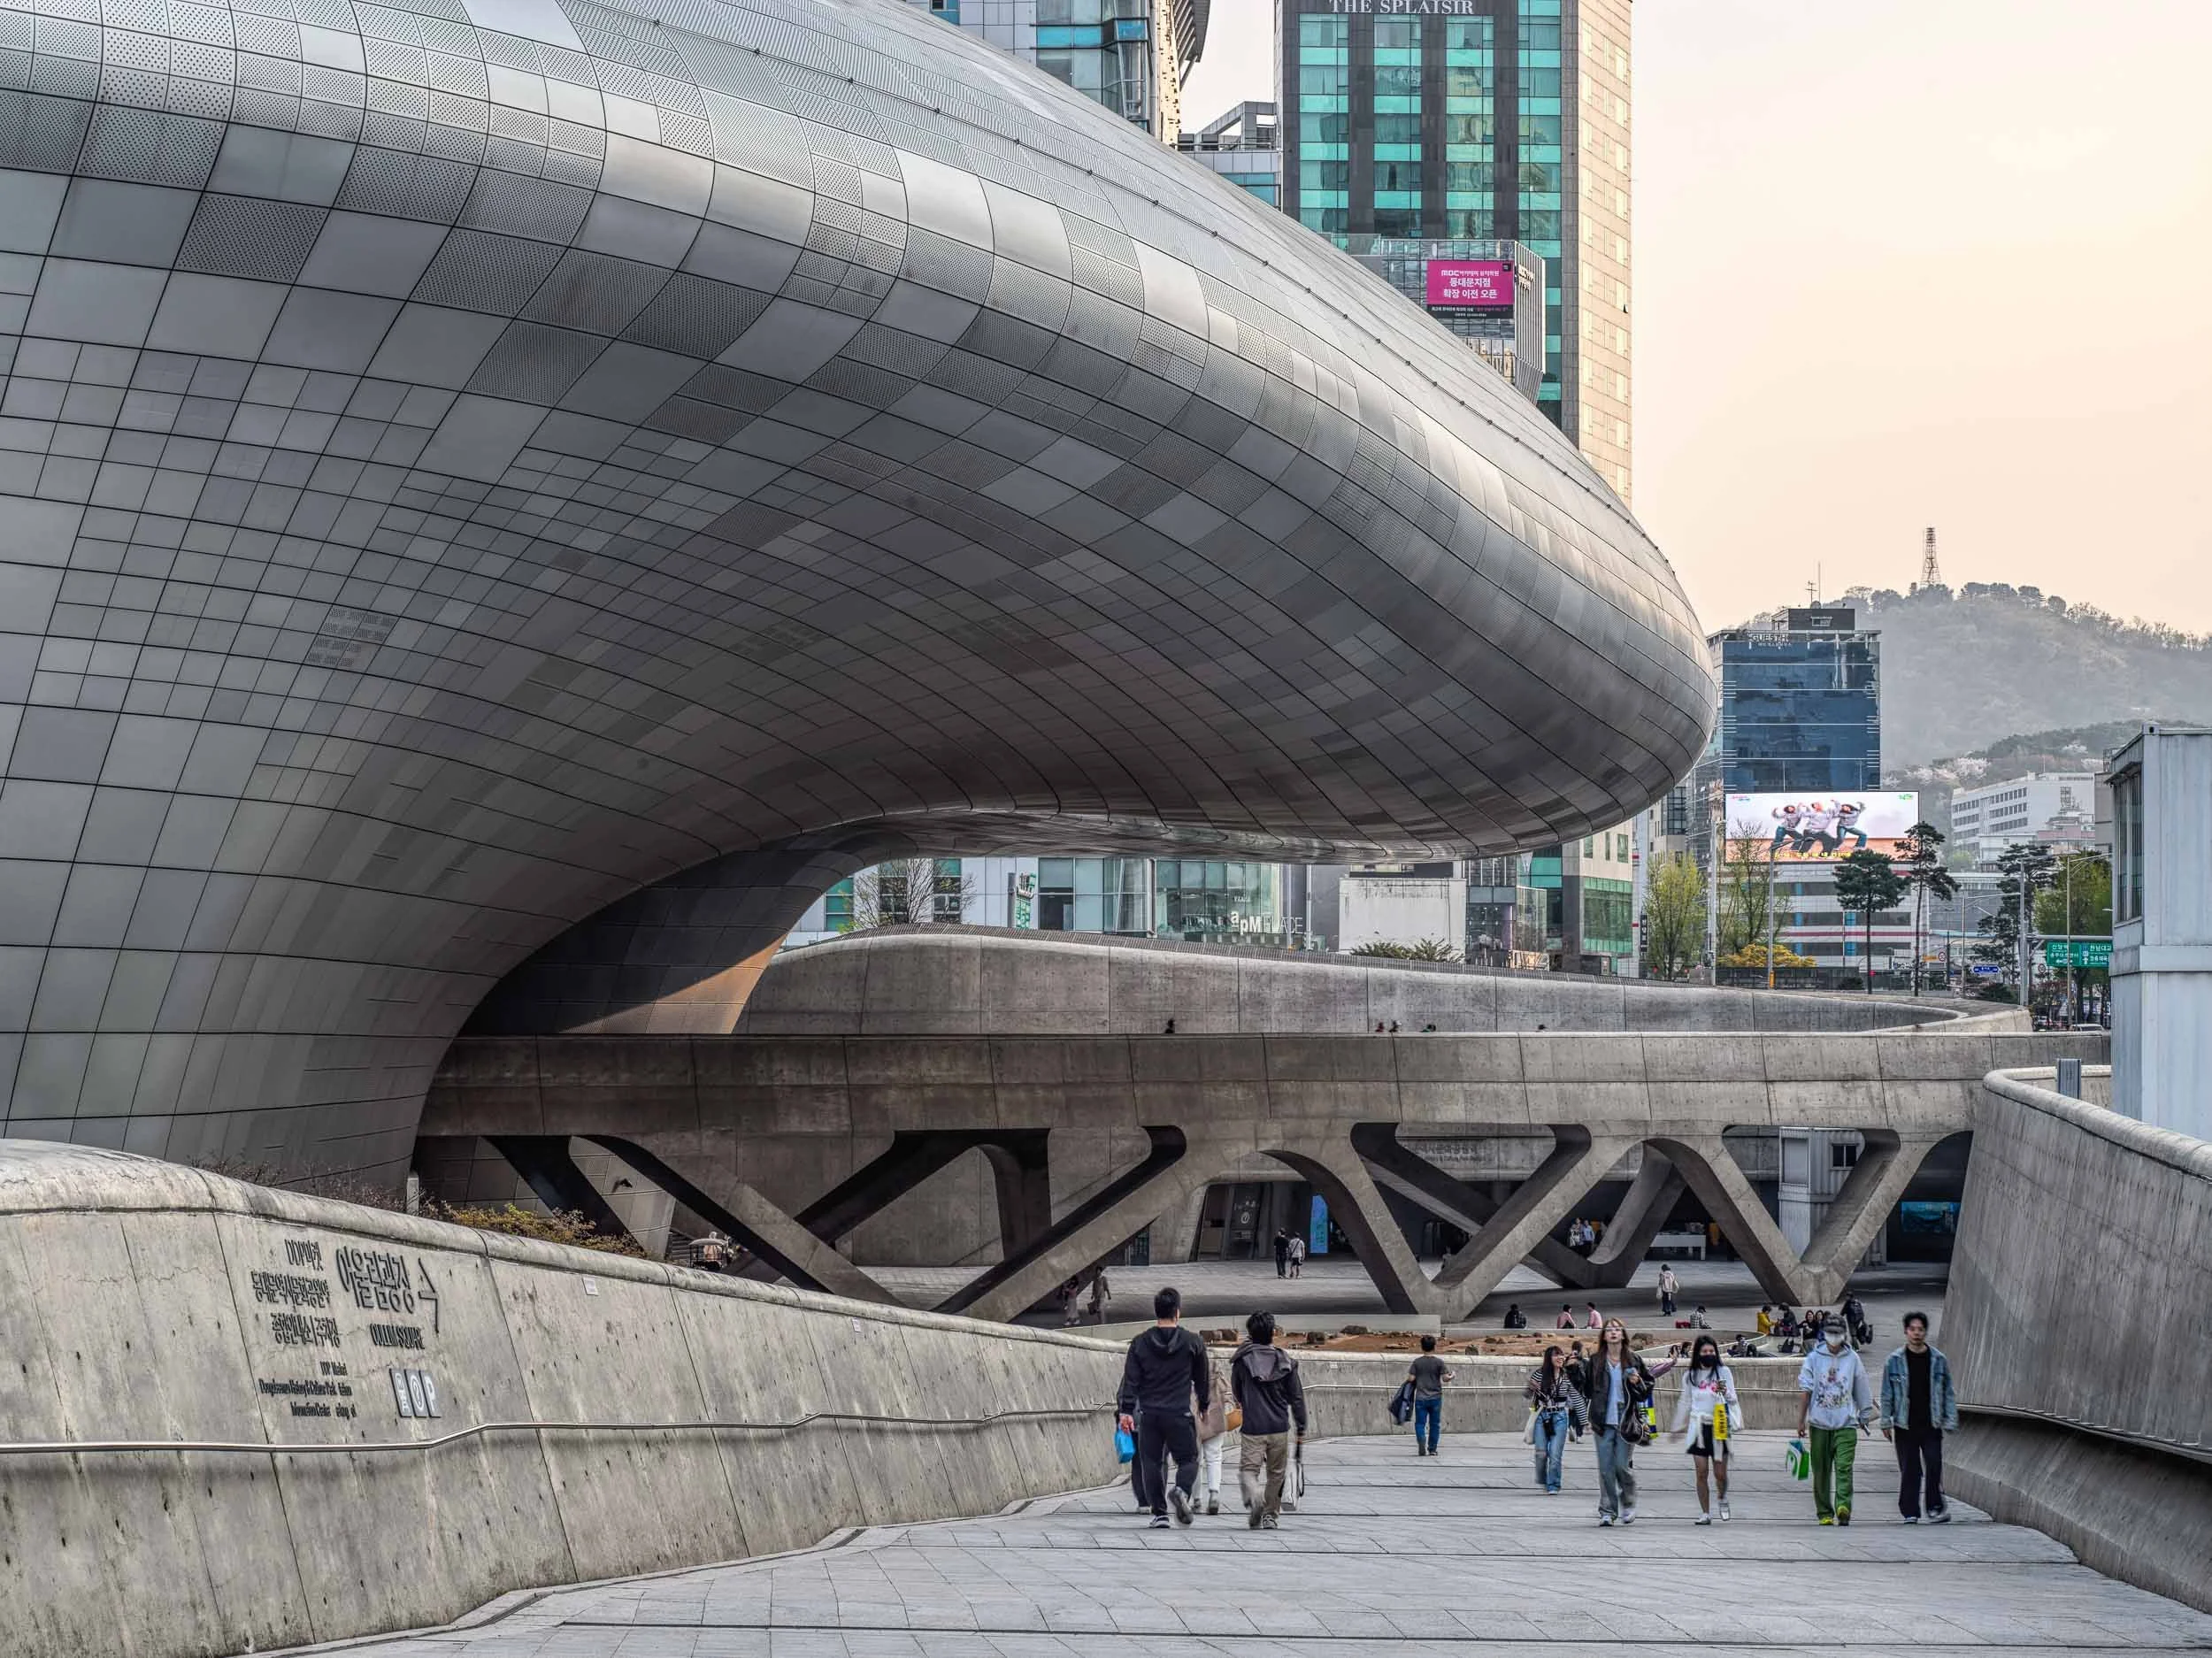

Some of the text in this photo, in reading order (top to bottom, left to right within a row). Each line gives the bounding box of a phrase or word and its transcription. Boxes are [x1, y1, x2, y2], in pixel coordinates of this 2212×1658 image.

[1329, 0, 1475, 14] THE SPLAISIR
[1449, 278, 1491, 288] 동대문지점
[1443, 289, 1498, 299] 확장 이전 오픈
[335, 1246, 414, 1315] 어울림광장
